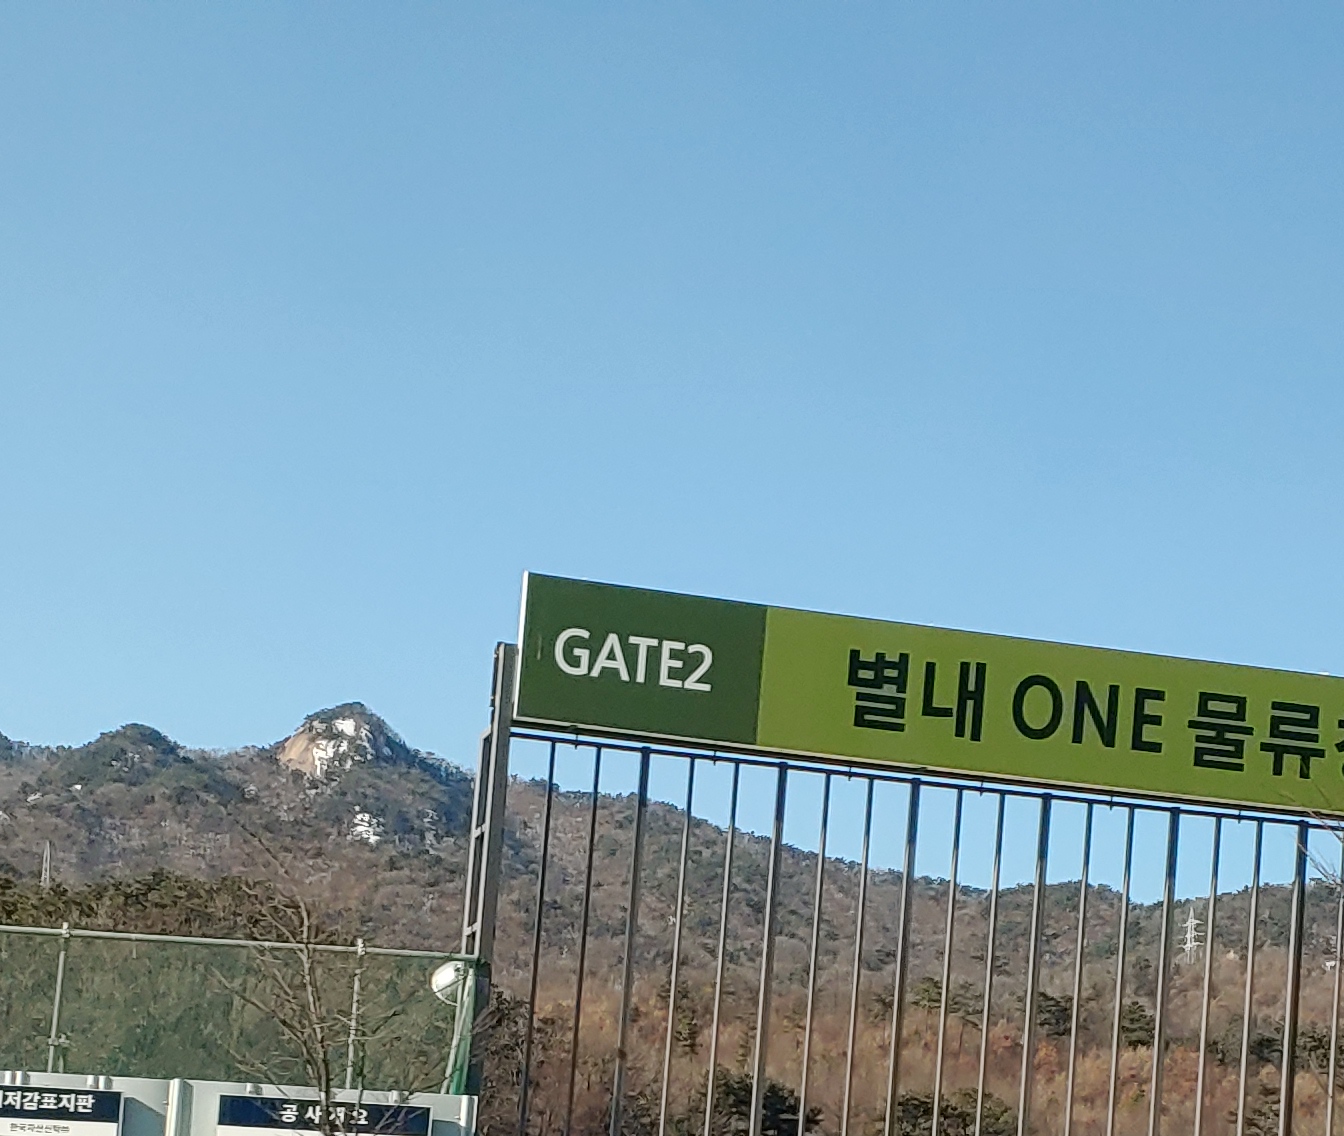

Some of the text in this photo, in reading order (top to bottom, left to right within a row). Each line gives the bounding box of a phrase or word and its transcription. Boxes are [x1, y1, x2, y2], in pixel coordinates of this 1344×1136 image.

[556, 628, 713, 692] GATE2
[848, 648, 987, 742] 별내
[1012, 674, 1165, 753] ONE
